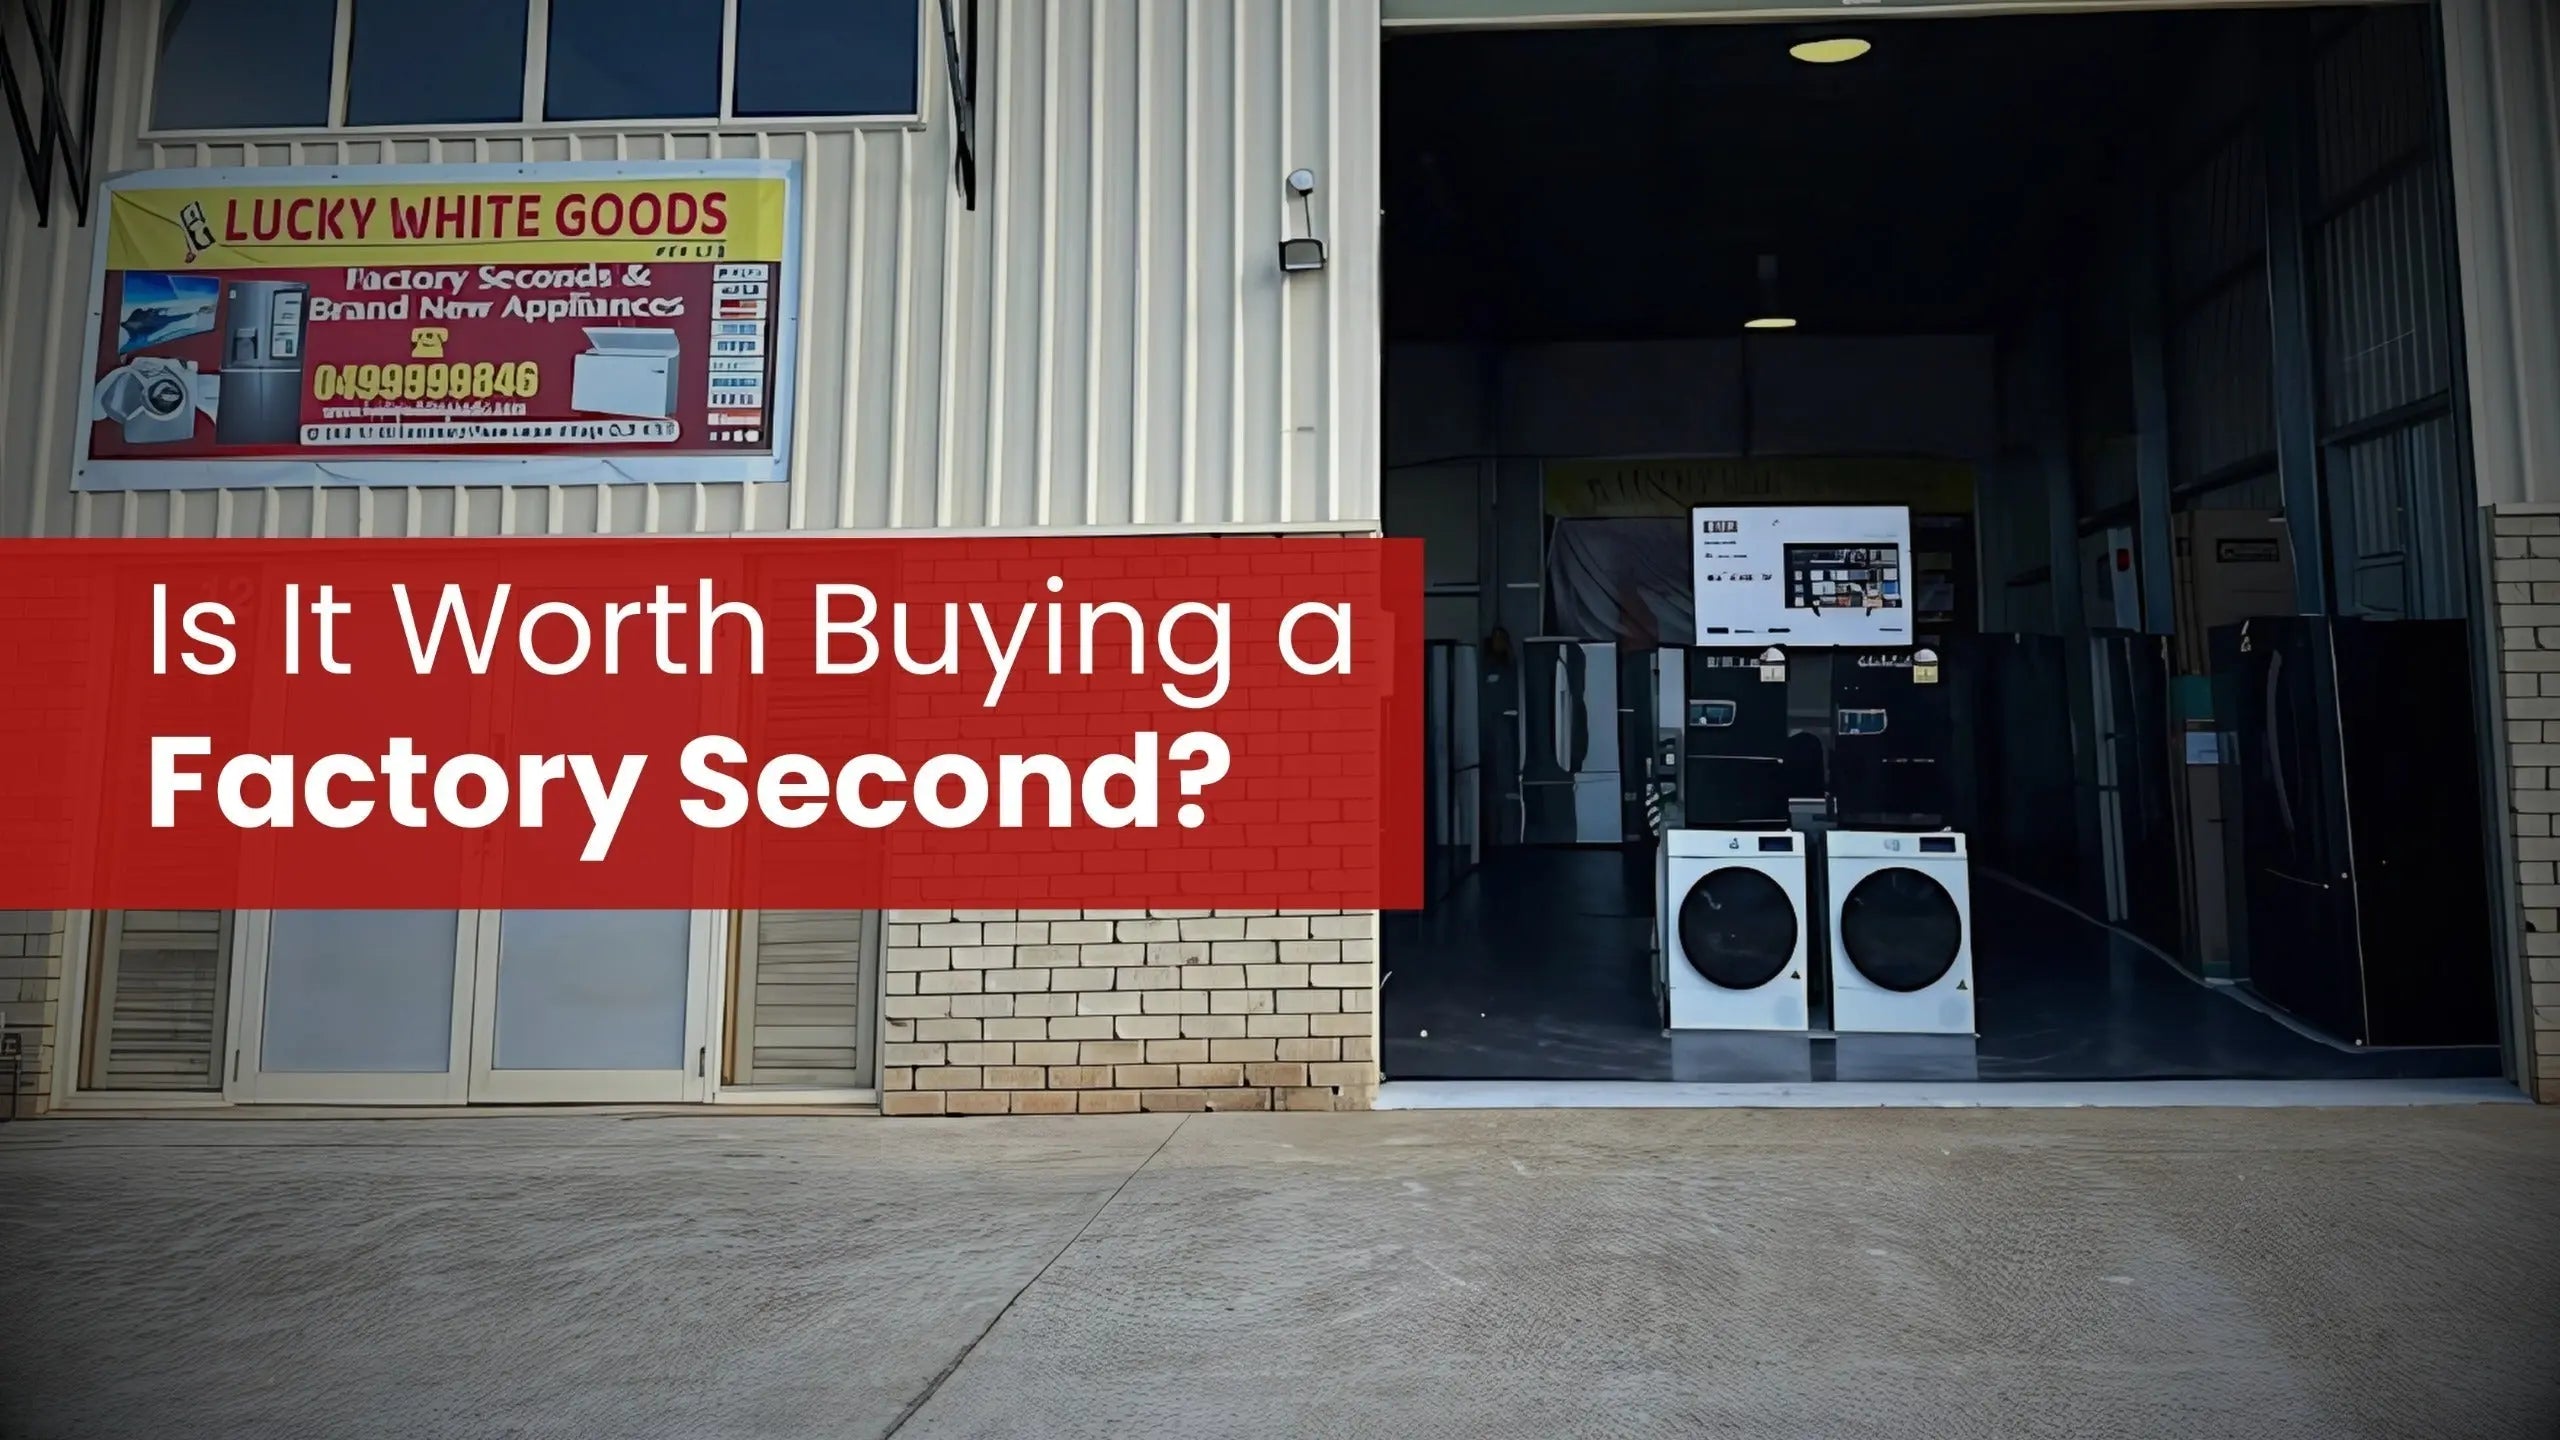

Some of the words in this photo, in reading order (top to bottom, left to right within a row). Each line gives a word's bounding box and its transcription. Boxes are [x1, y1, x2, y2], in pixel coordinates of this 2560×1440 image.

[225, 198, 376, 241] LUCKY
[391, 194, 541, 239] WHITE
[555, 191, 728, 237] GOODS
[621, 264, 652, 287] &
[309, 294, 409, 321] Brand
